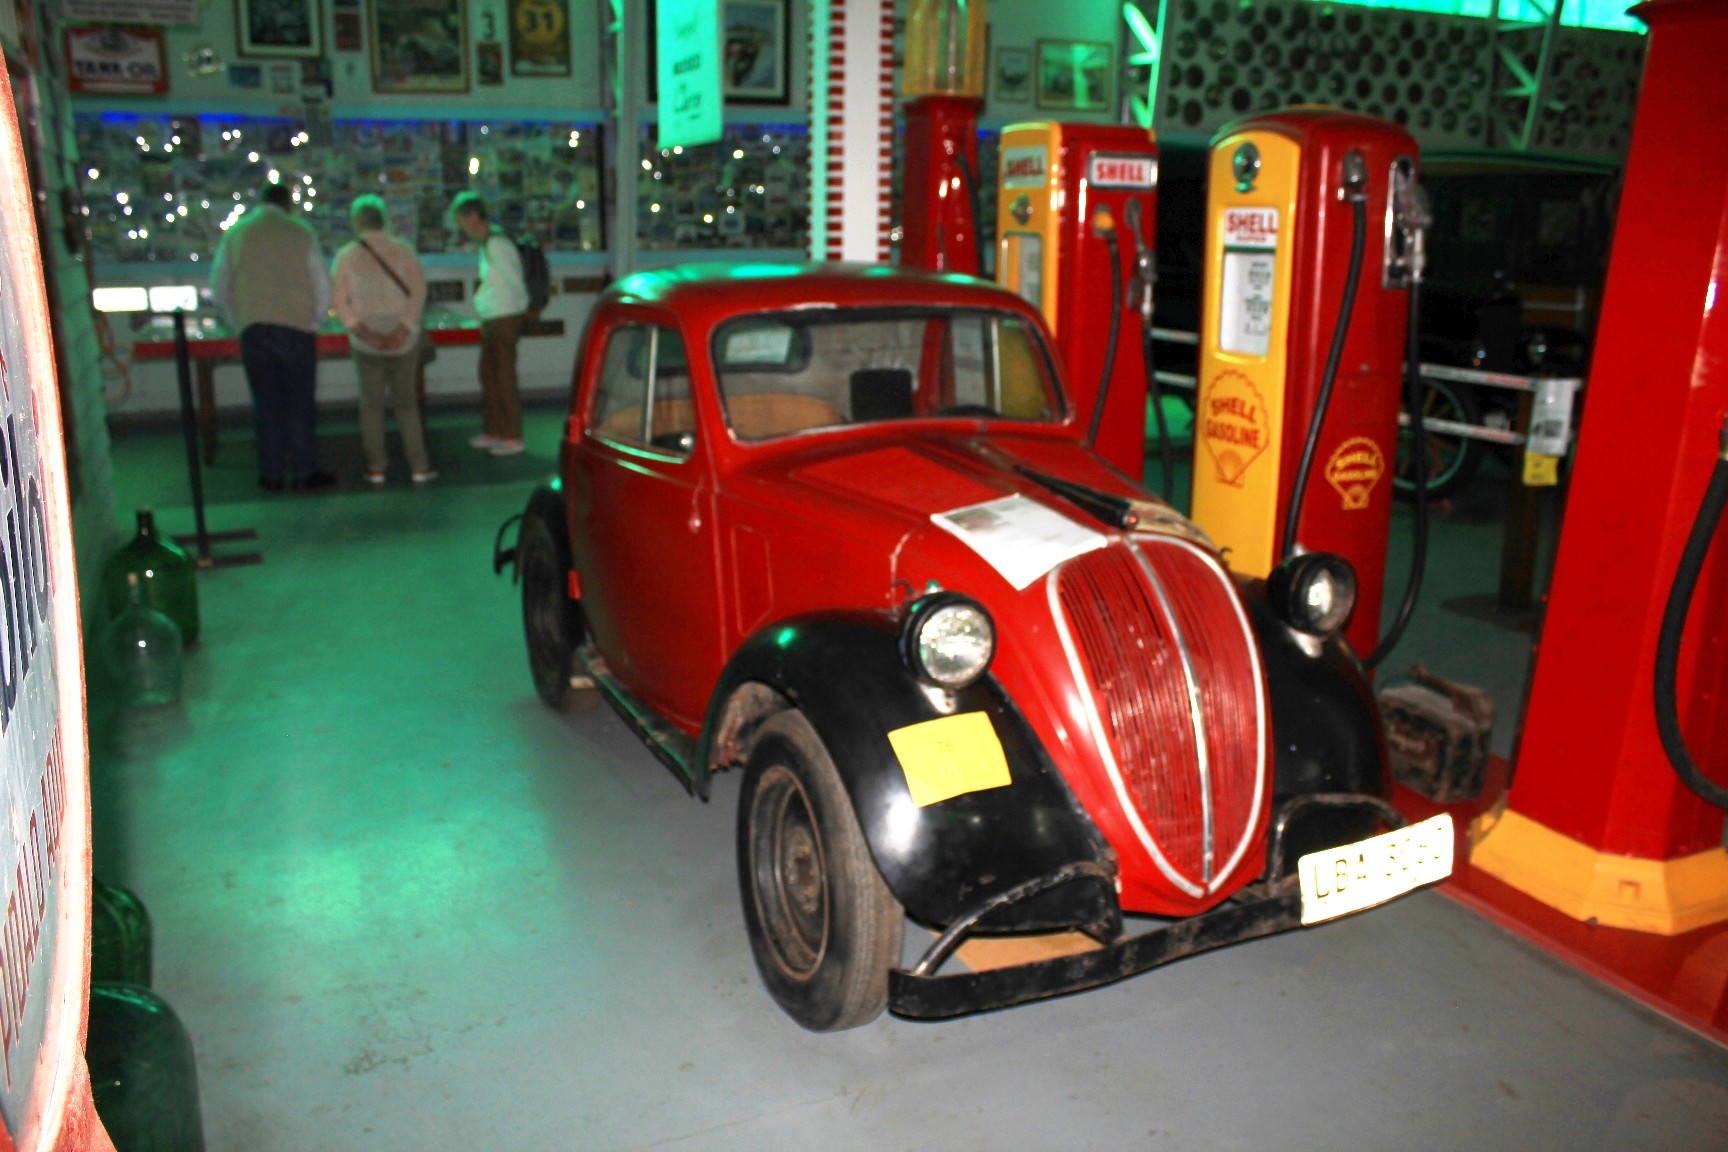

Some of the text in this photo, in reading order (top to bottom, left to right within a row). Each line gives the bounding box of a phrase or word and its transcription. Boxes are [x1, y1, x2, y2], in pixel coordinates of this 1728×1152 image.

[1007, 156, 1044, 178] SHELL
[1096, 162, 1144, 183] SHELL
[1226, 212, 1279, 233] SHELL
[1211, 397, 1257, 424] SHELL
[1206, 418, 1261, 450] GASOLINE
